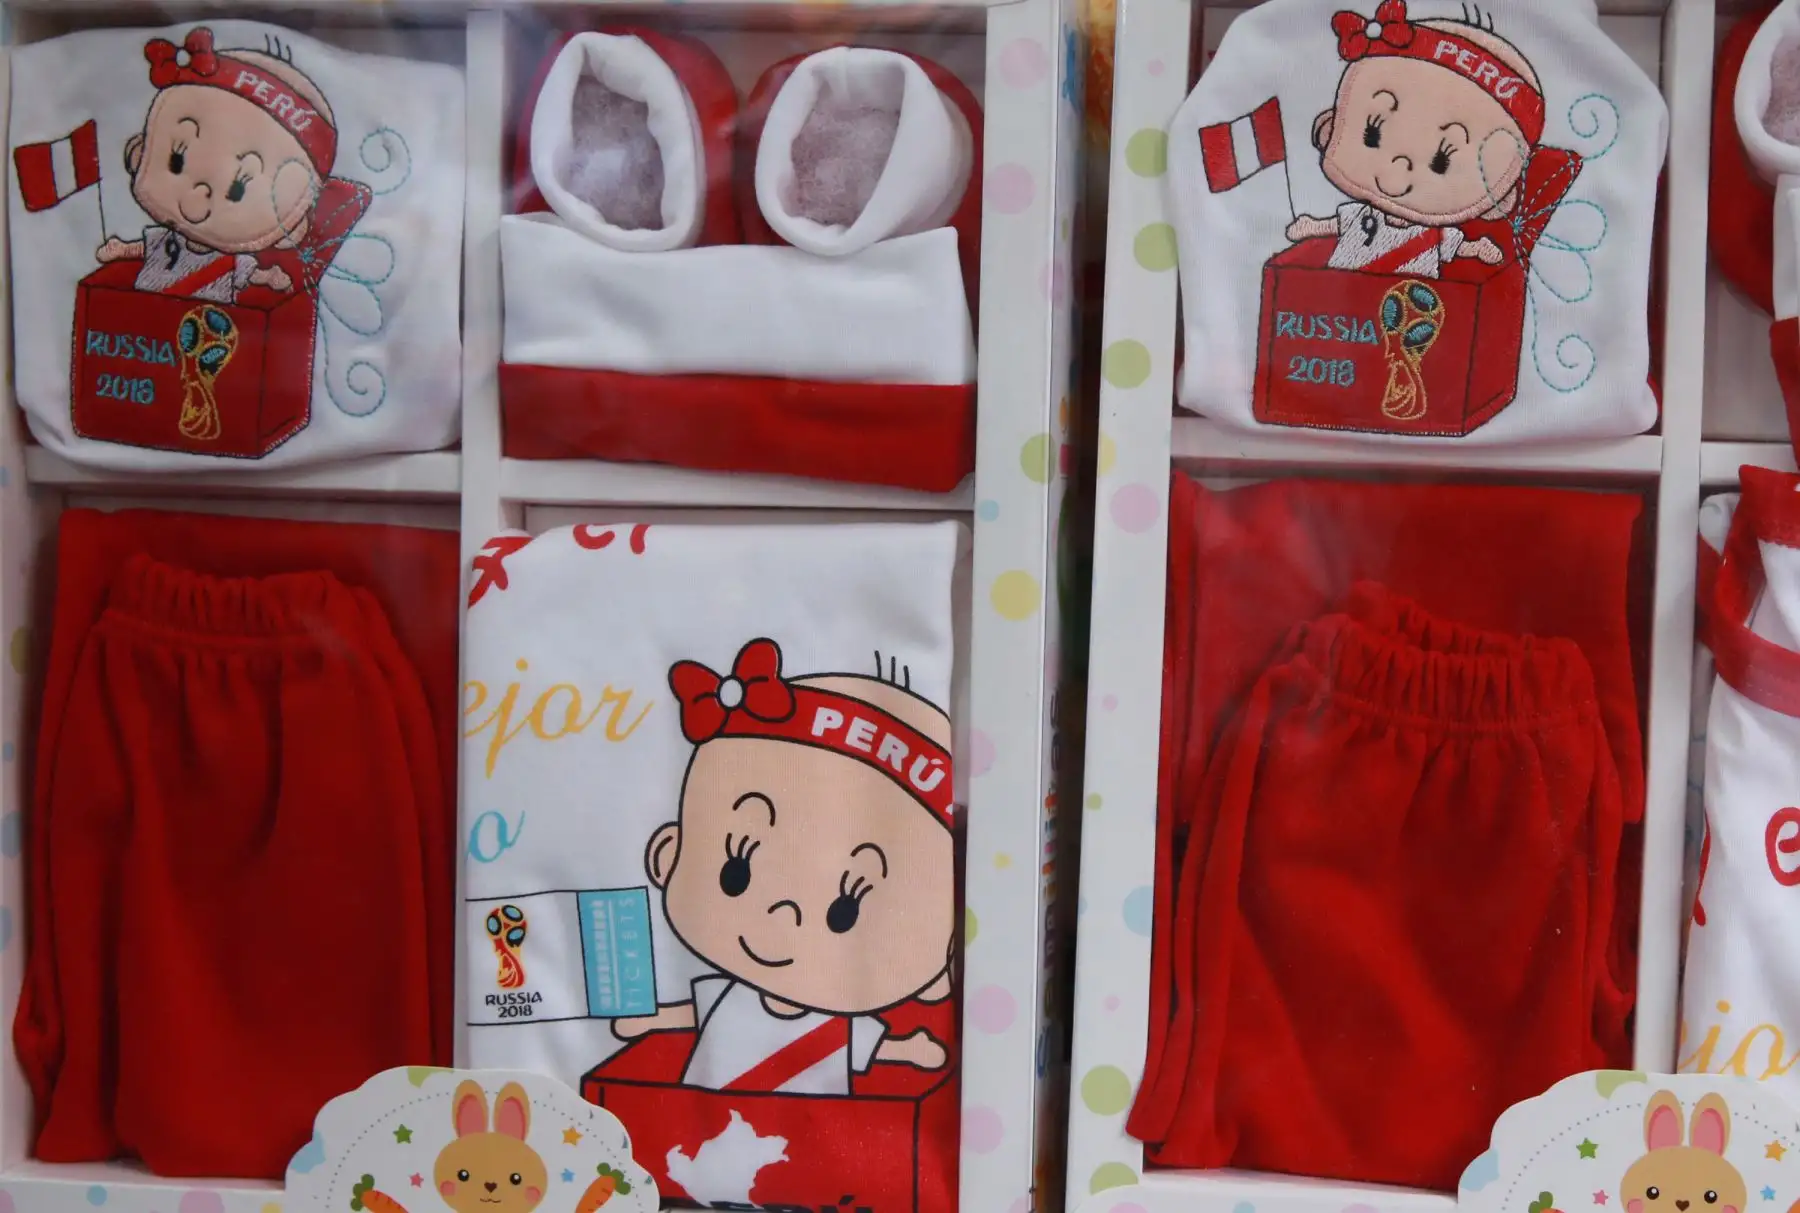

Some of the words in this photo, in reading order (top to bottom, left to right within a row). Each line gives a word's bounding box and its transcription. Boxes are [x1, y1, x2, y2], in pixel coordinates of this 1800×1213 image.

[1433, 39, 1525, 99] PERÚ
[233, 70, 318, 132] PERÚ
[1276, 310, 1380, 346] RUSSIA
[86, 329, 177, 367] RUSSIA
[95, 373, 156, 405] 2018
[1285, 355, 1355, 388] 2018
[811, 706, 946, 793] PERÚ
[485, 991, 544, 1006] RUSSIA
[498, 1003, 533, 1018] 2018
